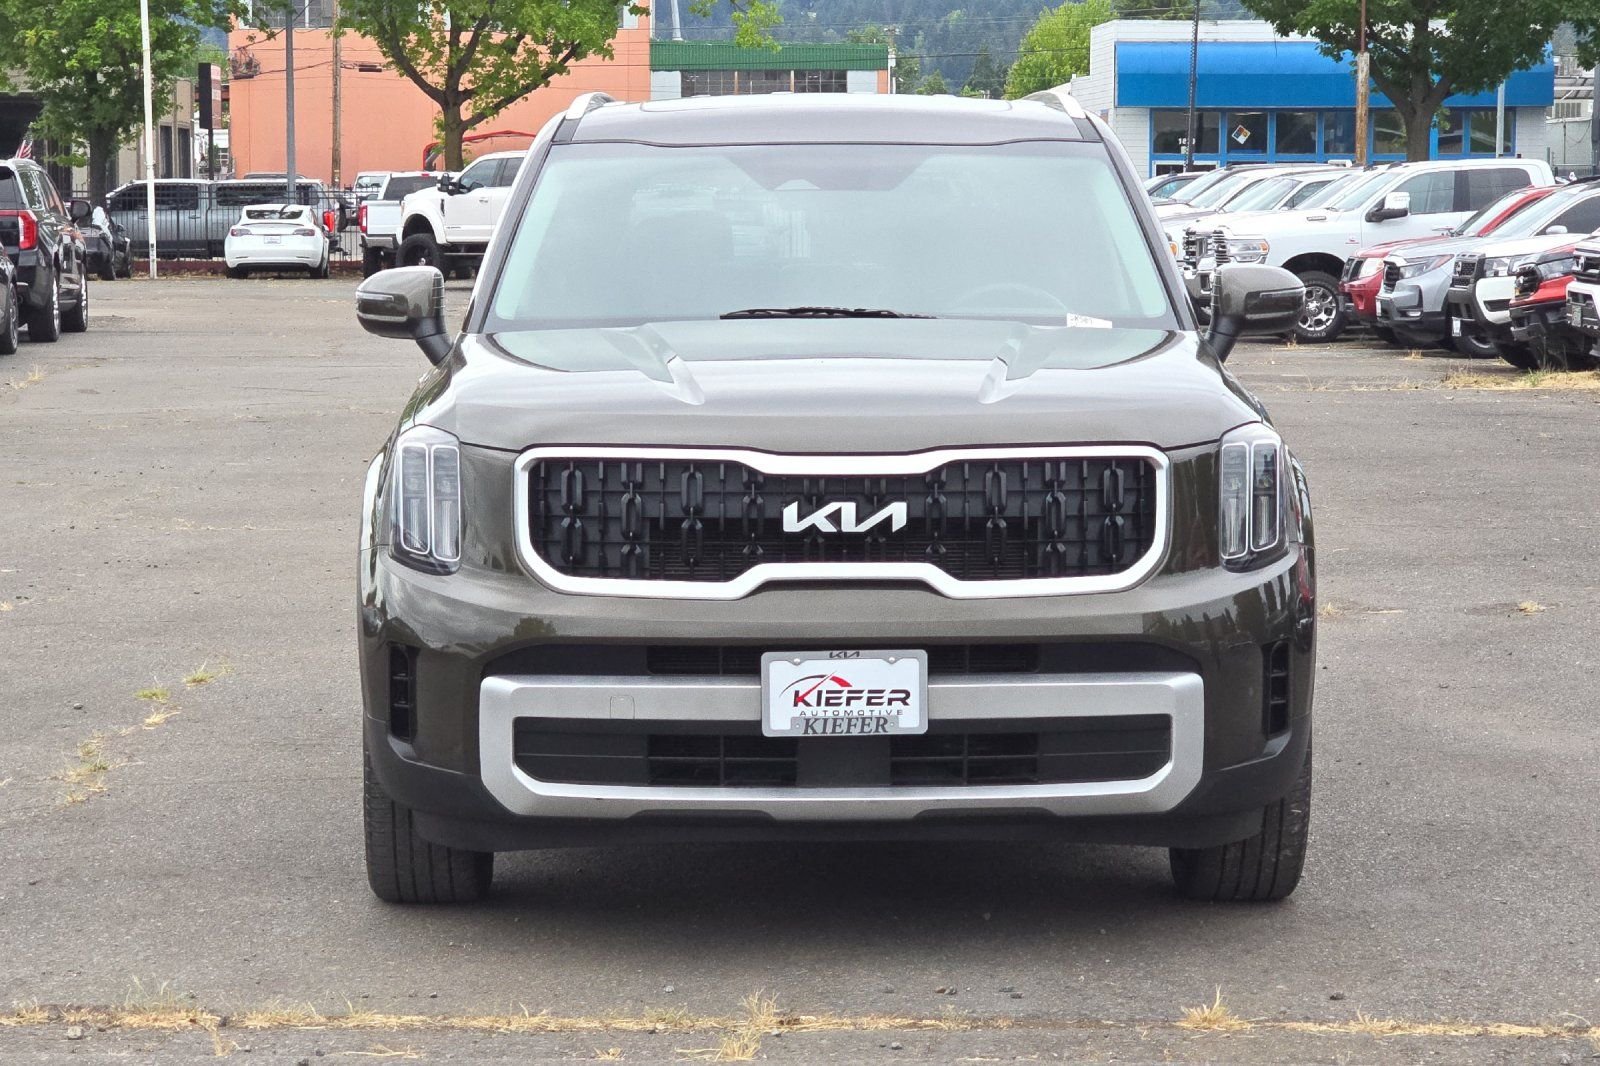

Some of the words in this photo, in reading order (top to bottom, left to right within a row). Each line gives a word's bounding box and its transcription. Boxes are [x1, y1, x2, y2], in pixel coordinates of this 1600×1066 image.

[783, 501, 907, 533] KIA
[829, 651, 860, 659] KIA
[793, 689, 911, 707] KIEFER
[802, 716, 889, 735] KIEFER
